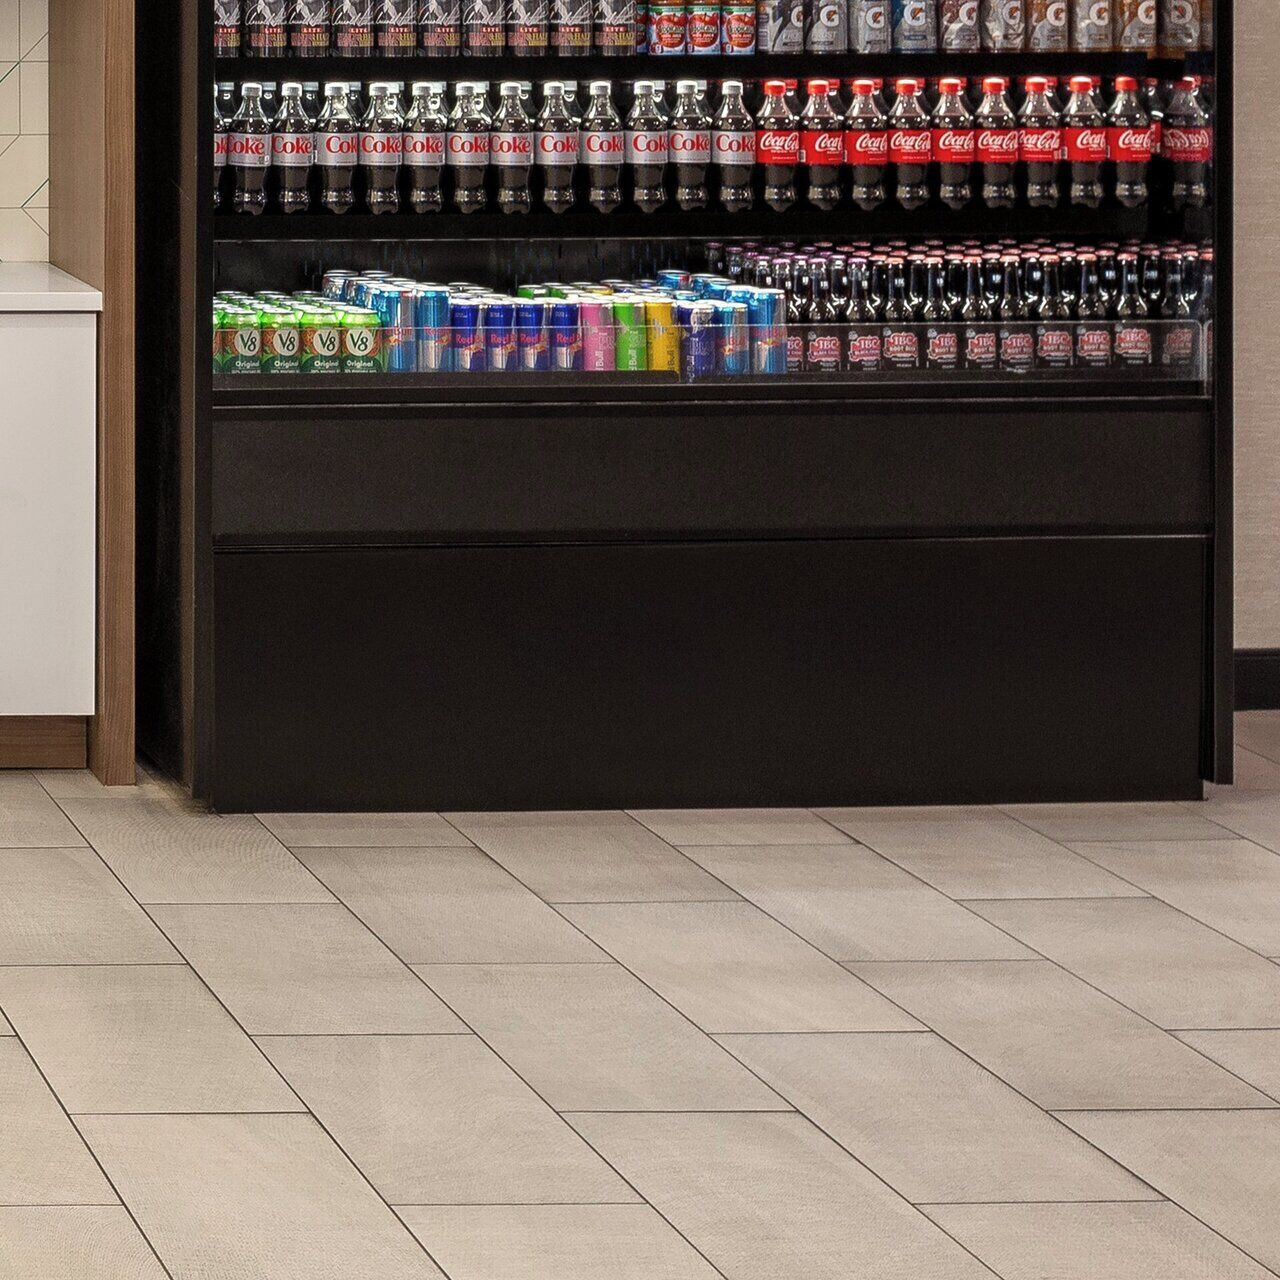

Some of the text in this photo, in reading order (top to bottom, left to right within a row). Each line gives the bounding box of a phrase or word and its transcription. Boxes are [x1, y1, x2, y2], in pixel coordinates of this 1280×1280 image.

[903, 1, 926, 26] G
[226, 135, 265, 154] Coke
[272, 135, 312, 154] Coke
[361, 135, 402, 154] Coke
[402, 135, 443, 153] Coke
[449, 135, 489, 153] Coke
[491, 135, 531, 153] Coke
[240, 331, 256, 352] V8
[278, 331, 296, 352] V8
[318, 331, 335, 352] V8
[350, 329, 368, 351] V8
[456, 334, 473, 344] Red
[491, 334, 509, 344] Red
[520, 334, 538, 344] Red
[557, 334, 574, 343] Red
[819, 339, 838, 349] IBC
[860, 339, 879, 349] IBC
[894, 334, 914, 345] IBC
[1048, 334, 1067, 345] IBC
[1125, 332, 1145, 342] IBC
[347, 360, 373, 368] Original
